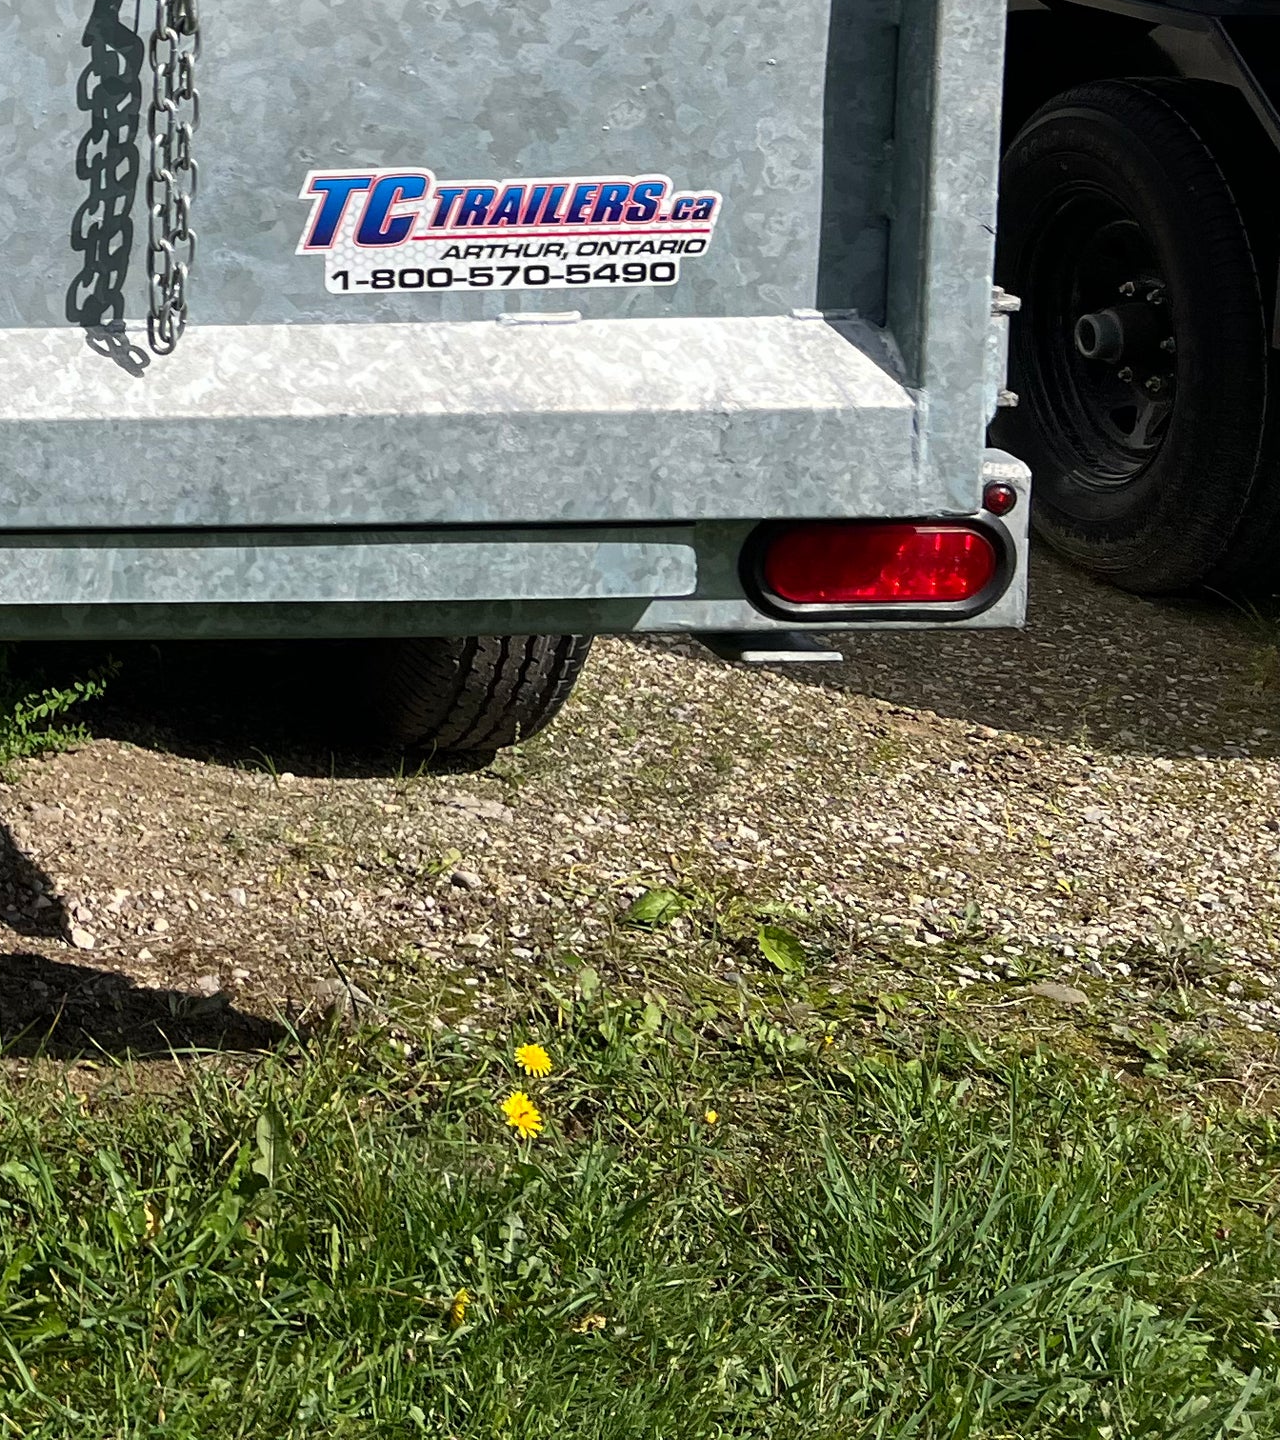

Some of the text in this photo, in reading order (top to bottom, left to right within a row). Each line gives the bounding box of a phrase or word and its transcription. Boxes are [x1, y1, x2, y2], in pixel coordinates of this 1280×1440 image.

[304, 174, 717, 249] TC TRAILERS.ca
[440, 238, 707, 261] ARTHUR, ONTARIO
[331, 262, 677, 291] 1-800-570-5490
